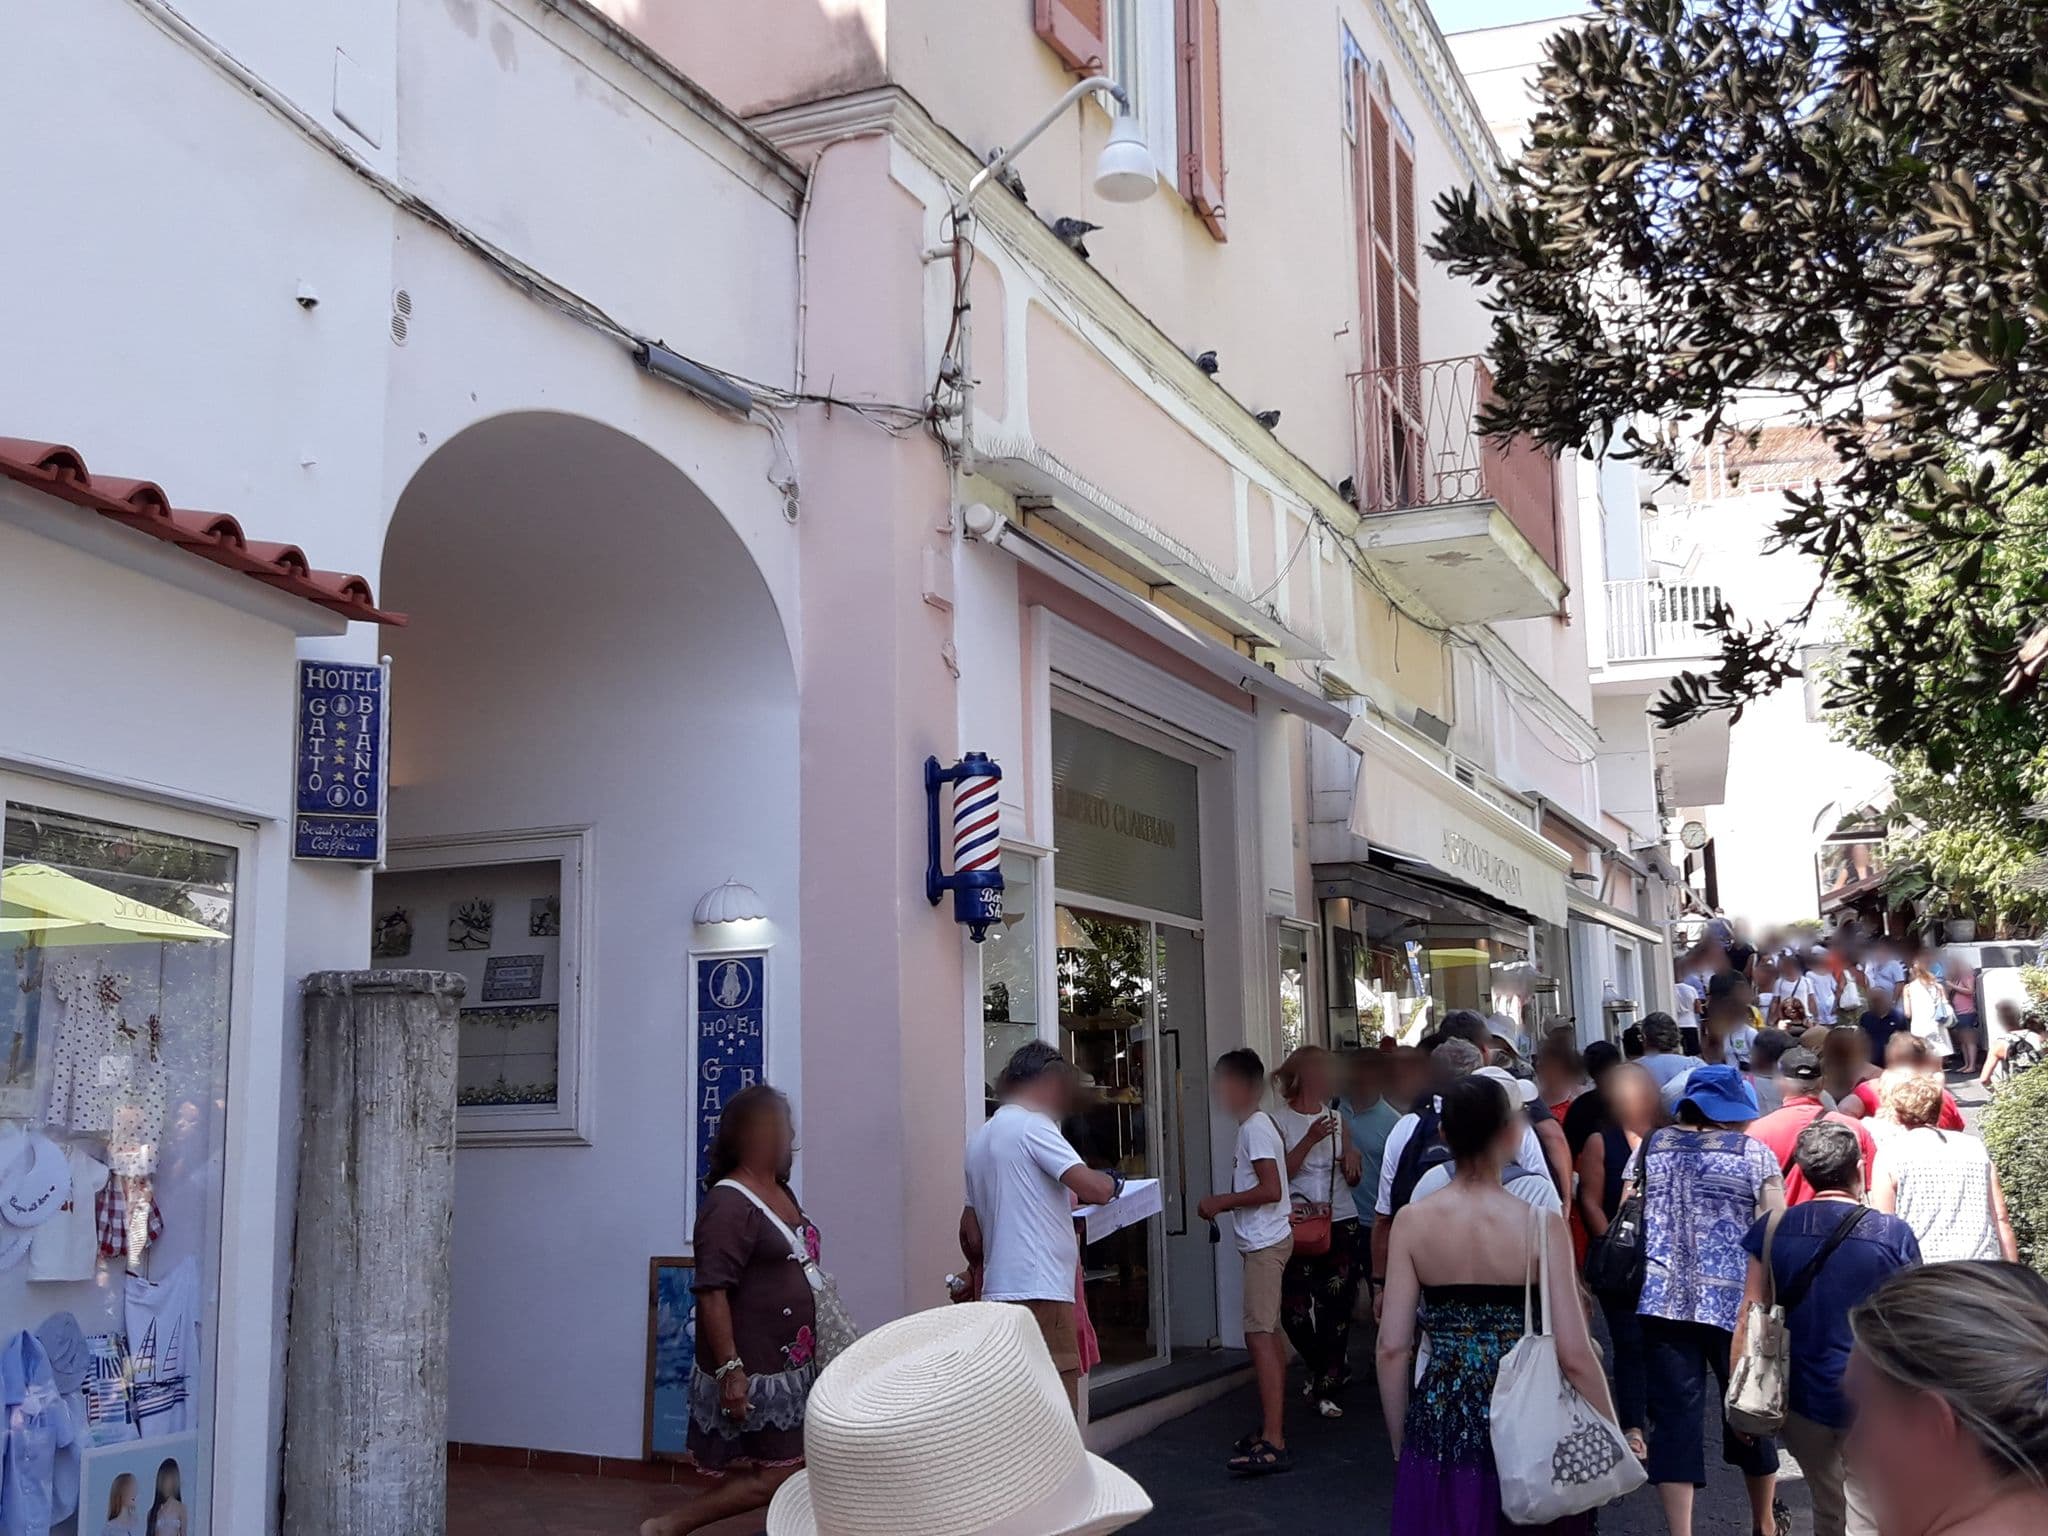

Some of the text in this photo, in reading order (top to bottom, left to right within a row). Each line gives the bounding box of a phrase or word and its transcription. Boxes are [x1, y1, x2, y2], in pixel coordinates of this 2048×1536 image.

[306, 667, 379, 692] HOTEL
[308, 698, 327, 791] GATTO
[353, 695, 374, 807] BIANCO
[299, 820, 376, 838] Beauty Center
[311, 836, 361, 856] Coiffeur
